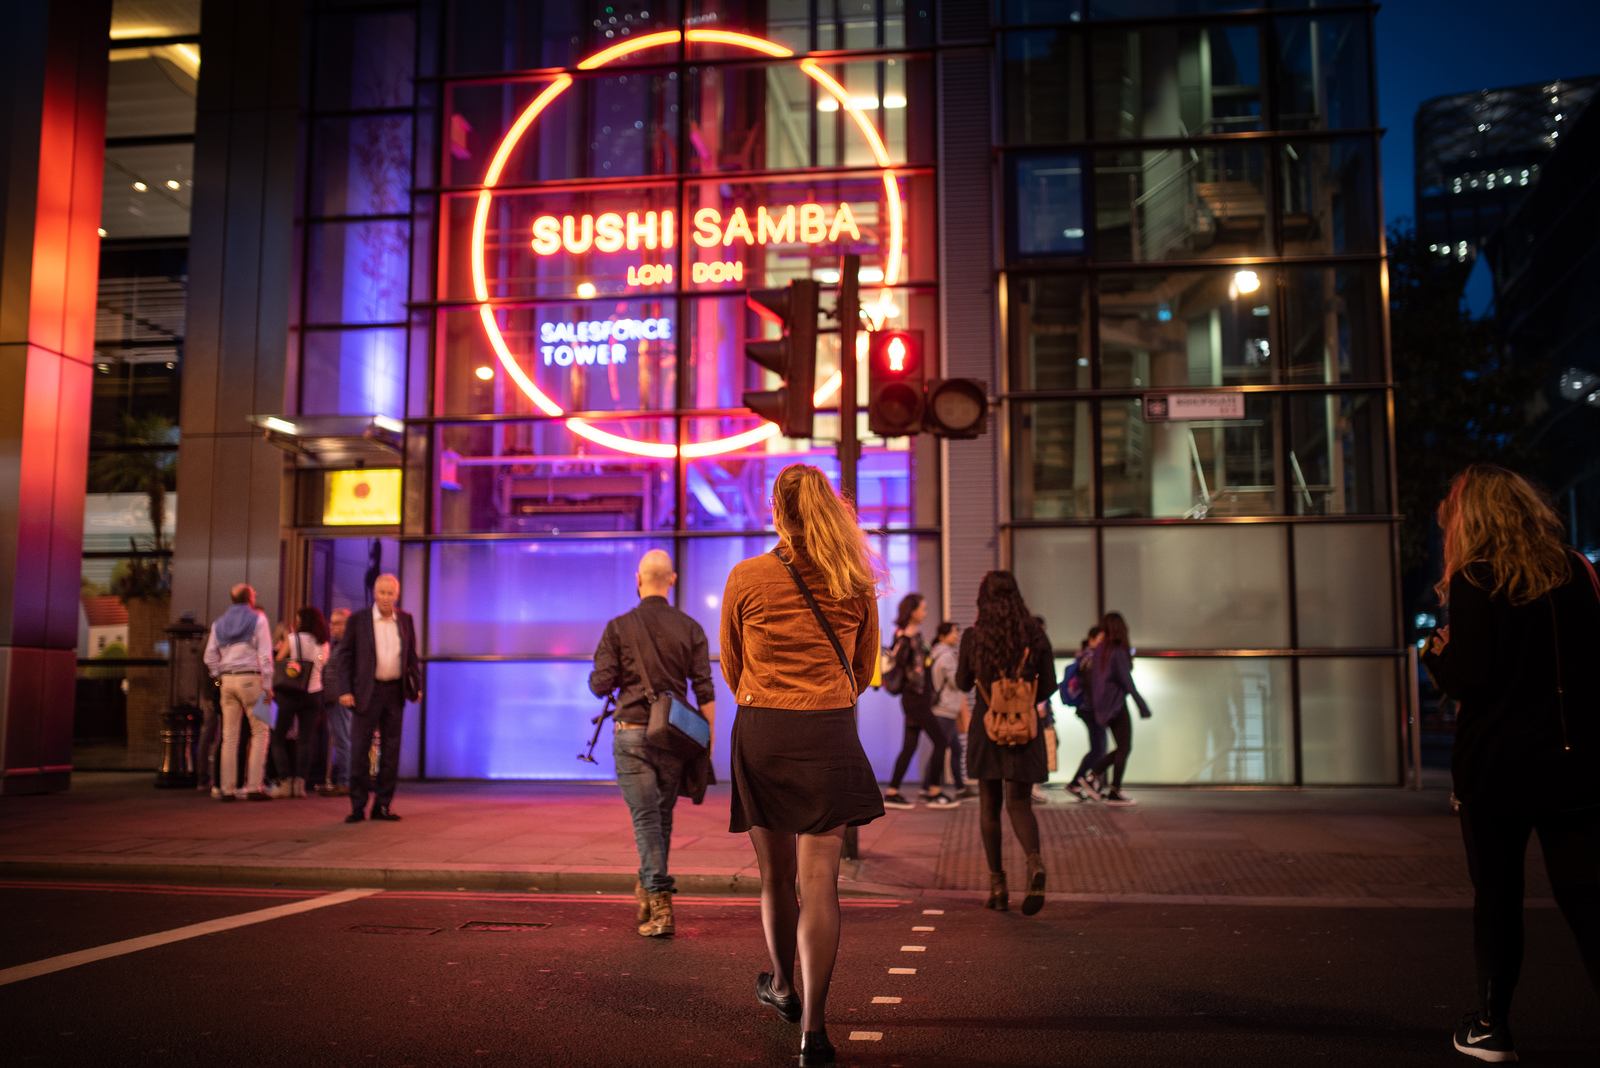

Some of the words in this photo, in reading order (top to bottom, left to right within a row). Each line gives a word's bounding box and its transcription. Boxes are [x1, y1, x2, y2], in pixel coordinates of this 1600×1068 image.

[531, 210, 674, 256] SUSHI
[692, 202, 861, 248] SAMBA
[627, 264, 673, 286] LON
[692, 261, 743, 284] DON
[540, 318, 671, 343] SALESFORCE
[540, 343, 627, 367] TOWER
